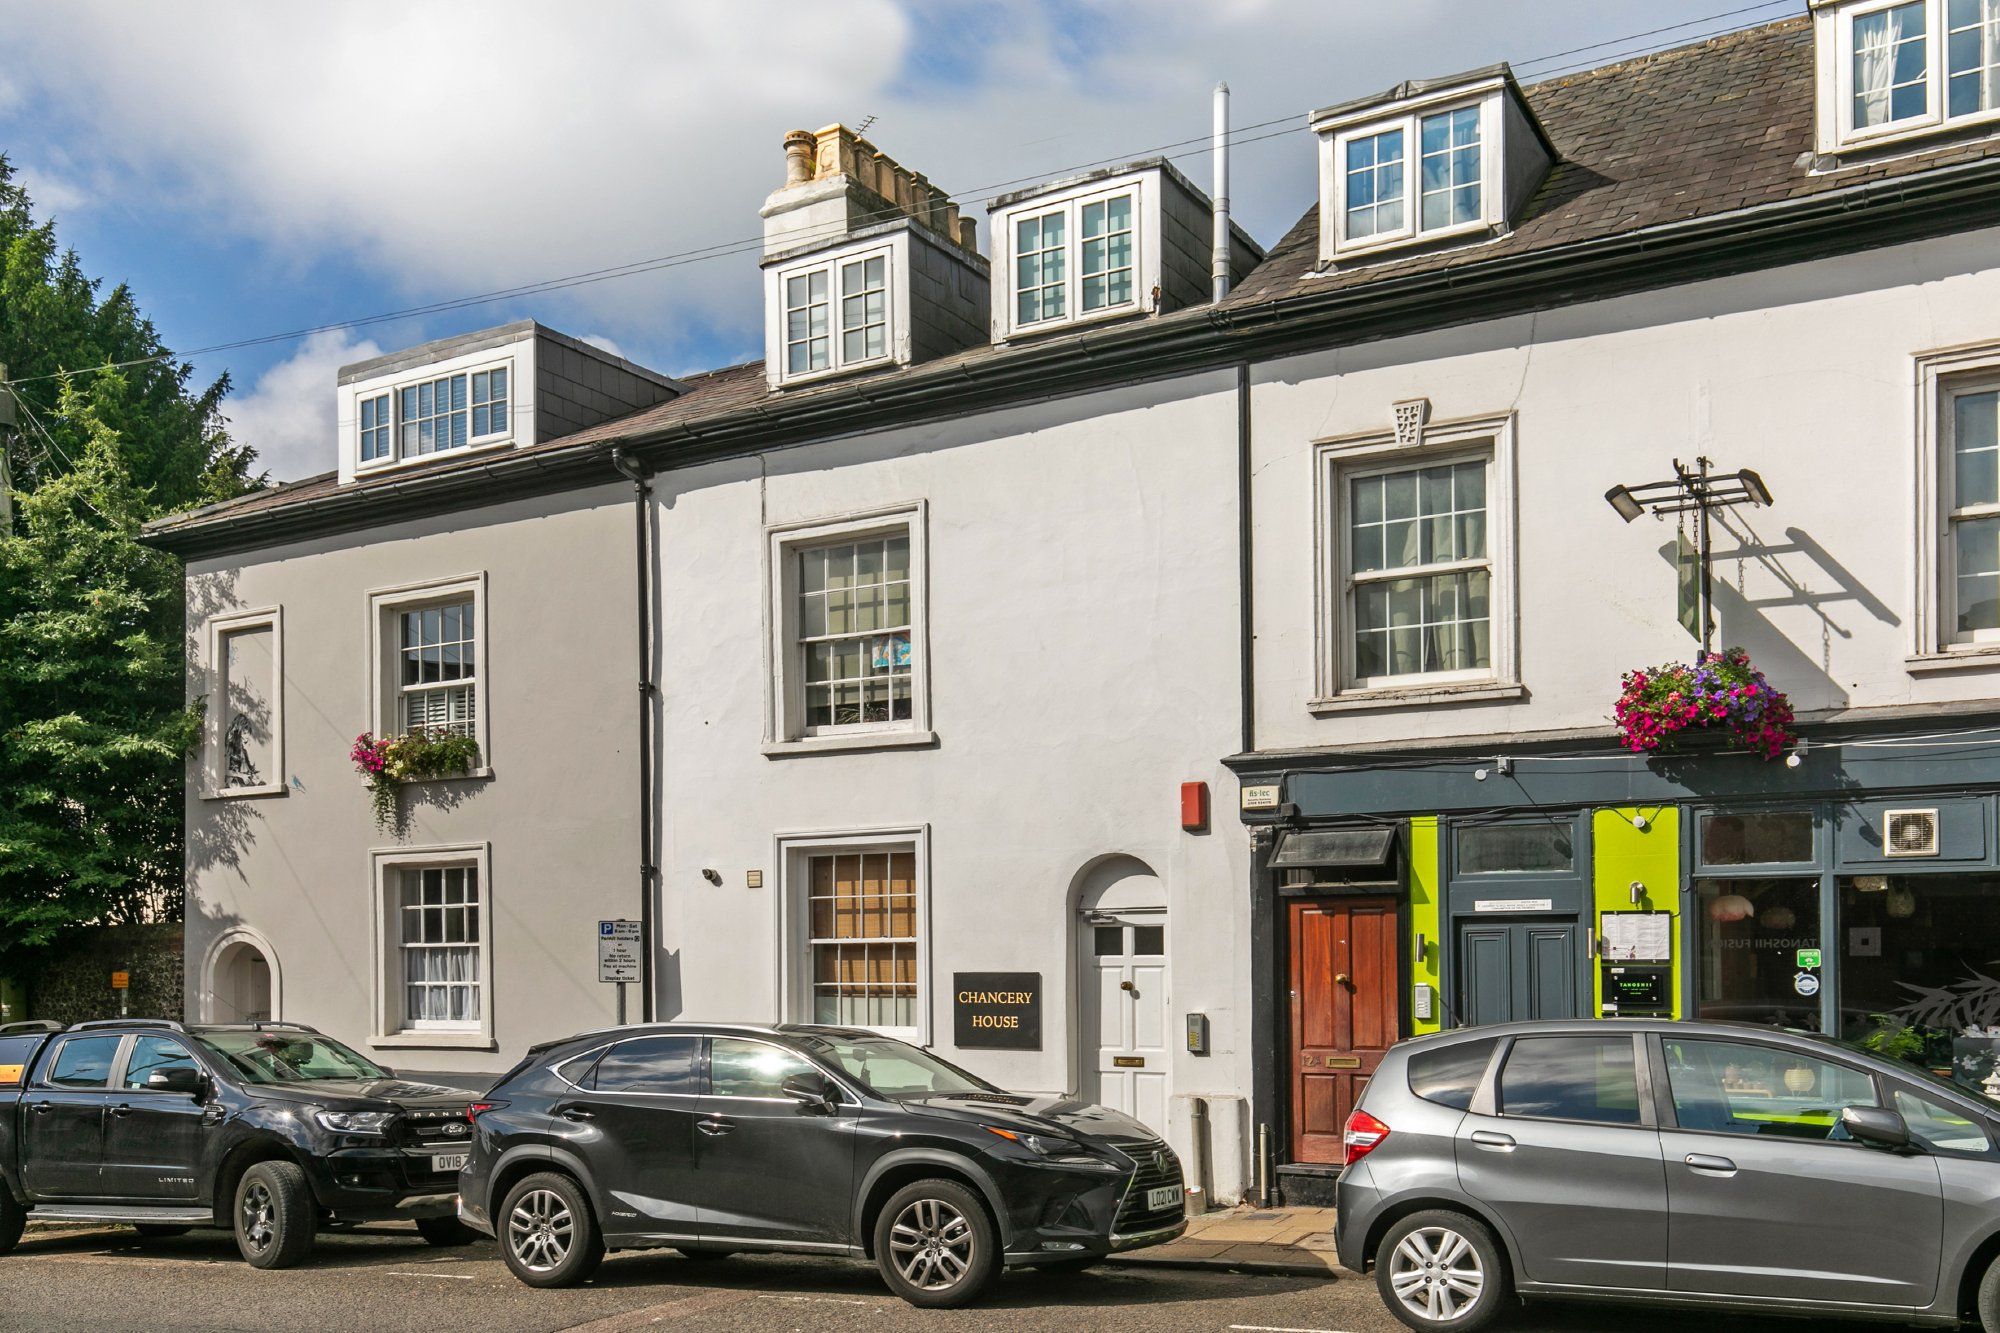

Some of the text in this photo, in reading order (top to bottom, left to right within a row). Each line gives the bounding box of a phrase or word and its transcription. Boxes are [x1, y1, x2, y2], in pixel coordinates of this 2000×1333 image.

[604, 924, 611, 934] P
[958, 991, 1033, 1004] CHANCERY
[972, 1015, 1019, 1028] HOUSE
[439, 1156, 462, 1168] OV18
